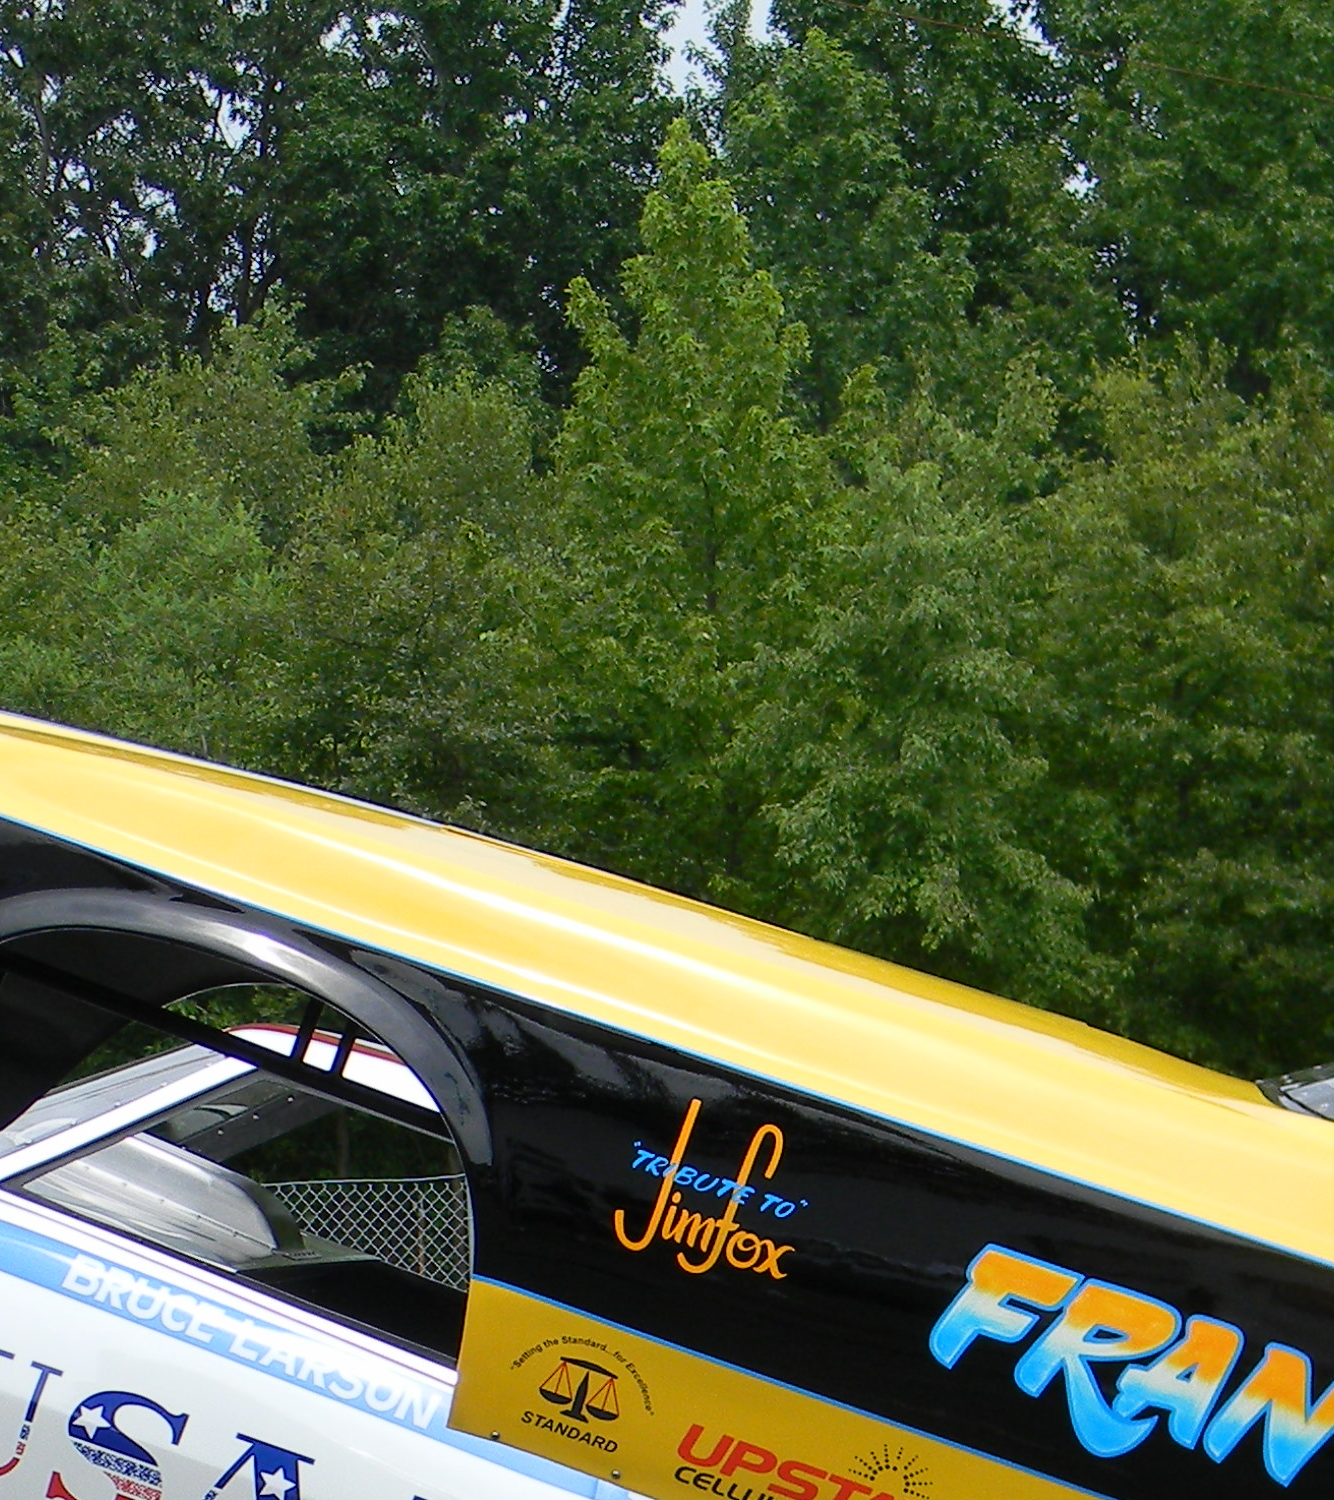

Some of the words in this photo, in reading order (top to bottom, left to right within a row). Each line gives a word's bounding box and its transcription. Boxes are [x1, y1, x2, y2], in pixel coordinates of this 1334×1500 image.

[61, 1252, 228, 1343] BRUCE
[228, 1315, 442, 1430] LARSON
[544, 1337, 560, 1348] the
[521, 1410, 618, 1453] STANDARD
